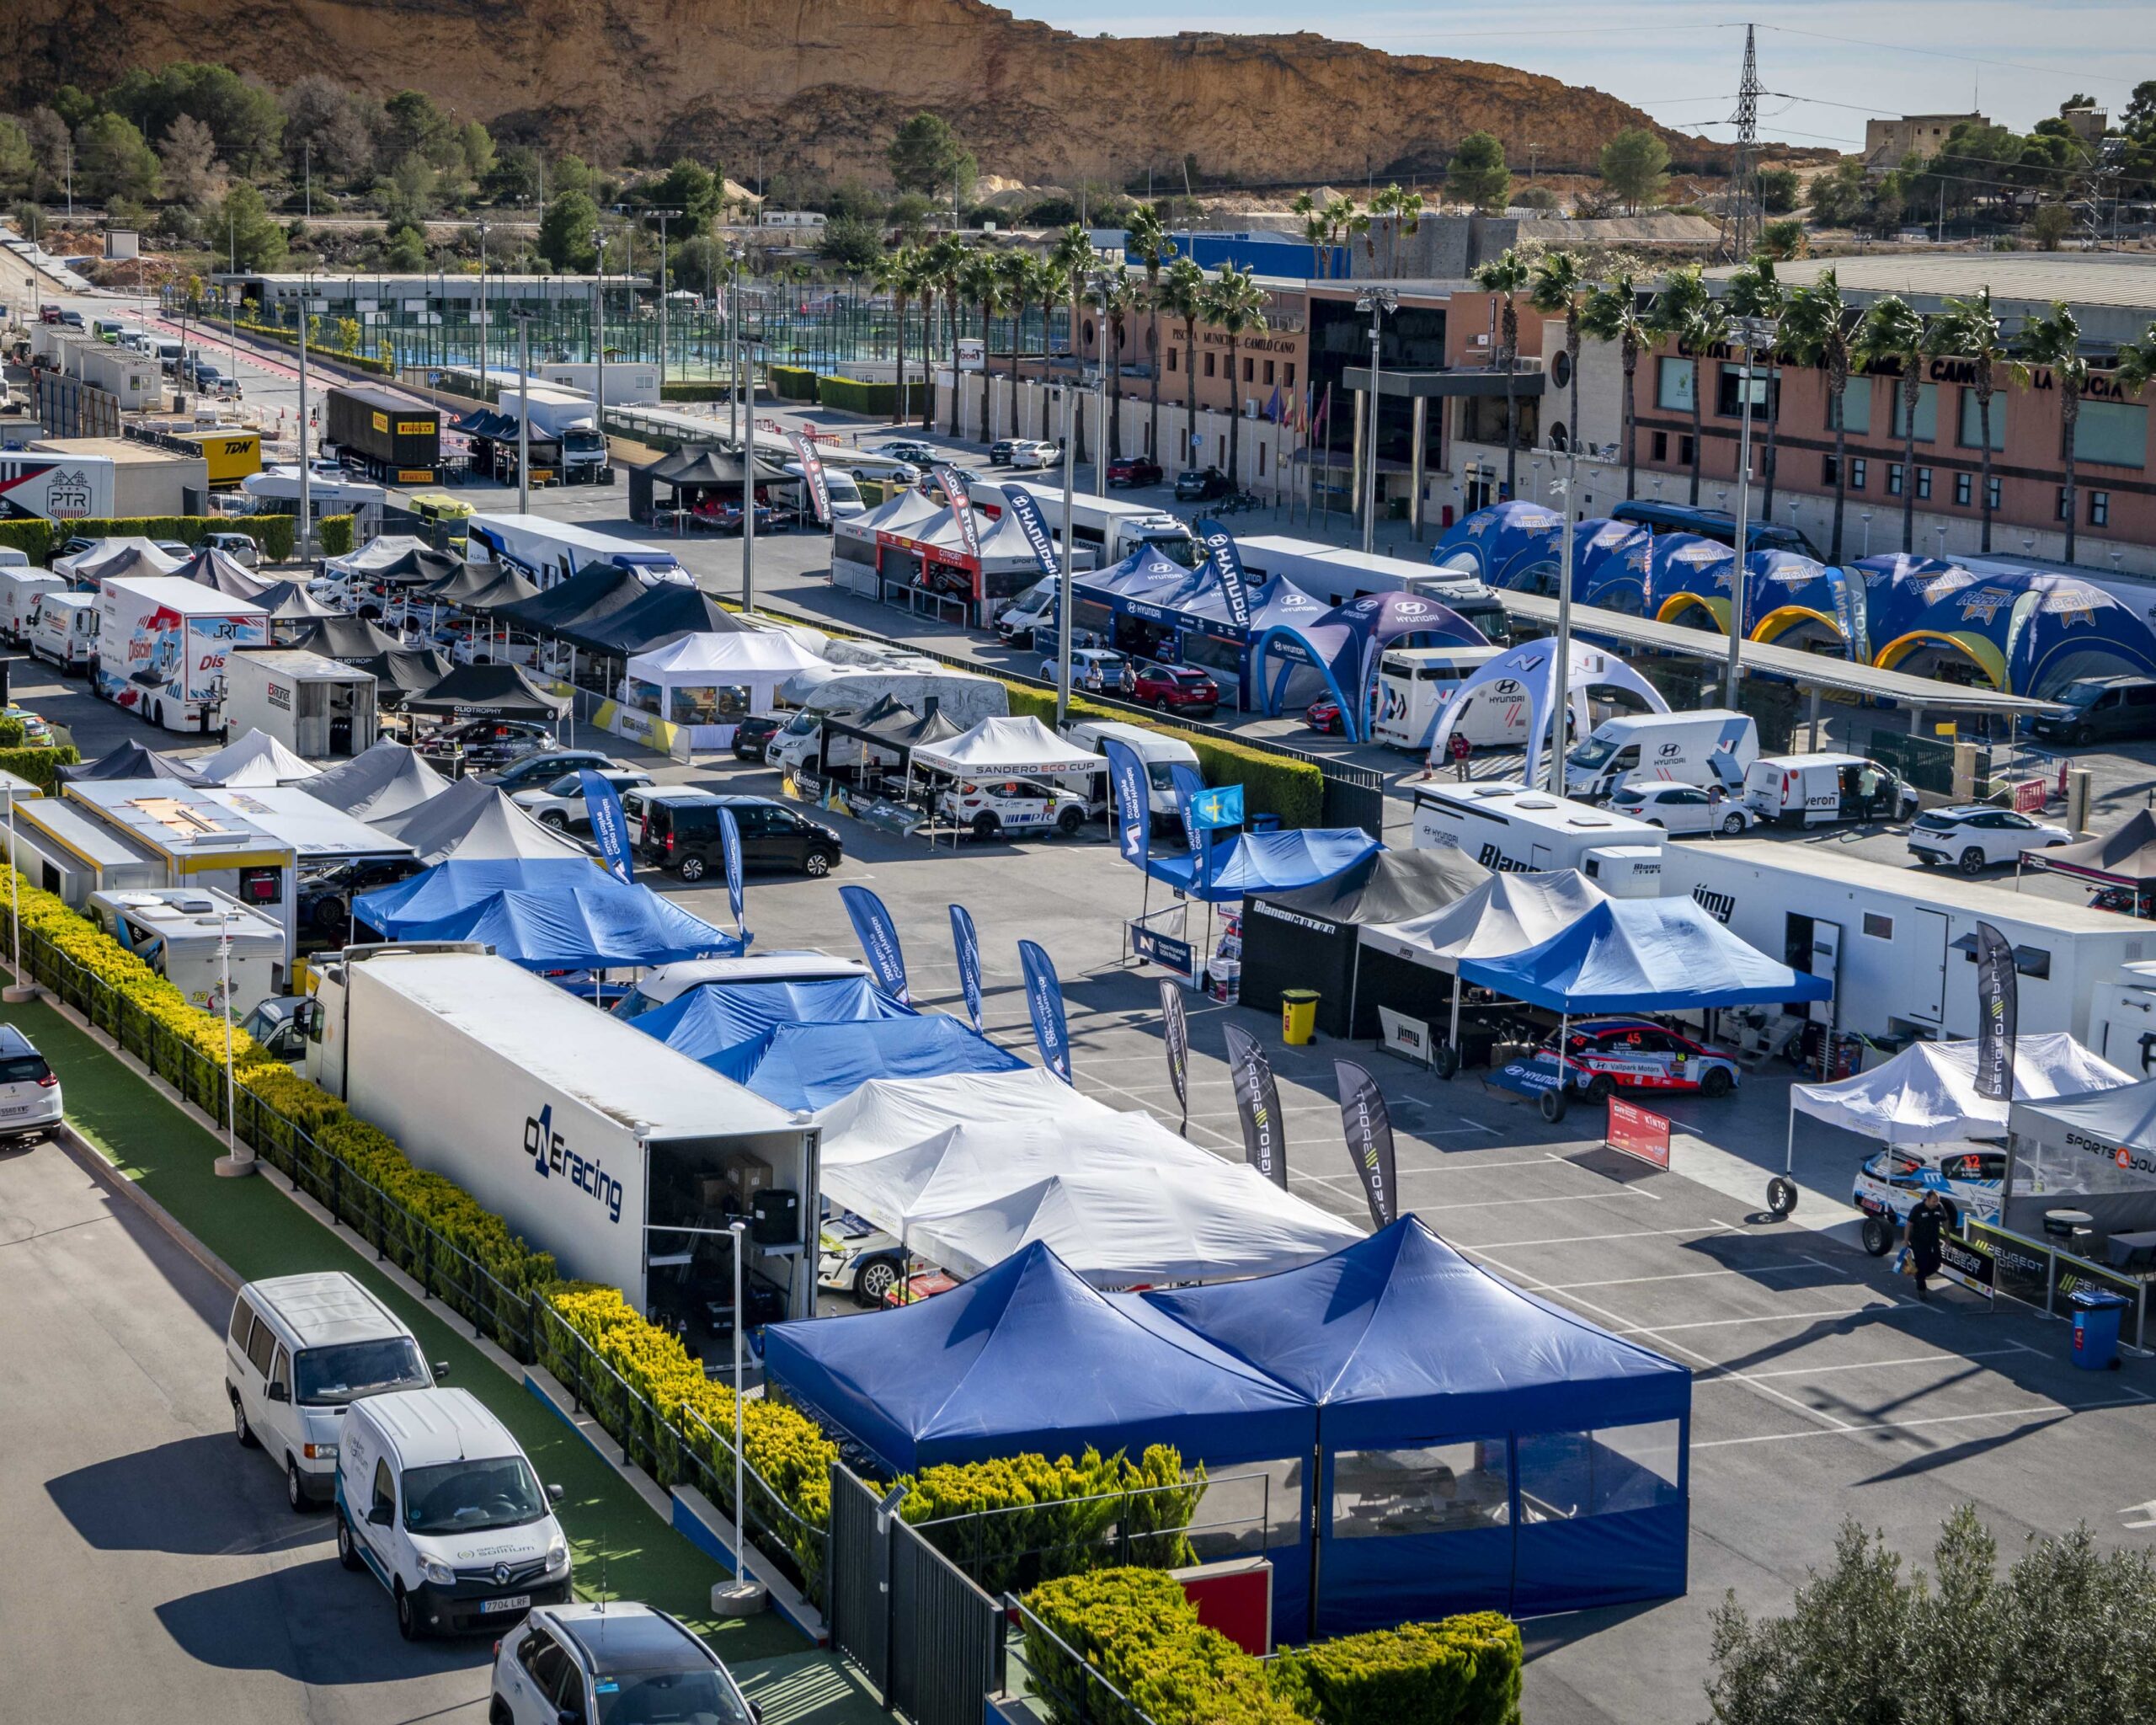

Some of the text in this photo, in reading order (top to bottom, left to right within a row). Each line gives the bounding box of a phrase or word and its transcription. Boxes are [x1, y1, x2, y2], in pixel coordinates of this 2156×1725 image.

[1245, 337, 1273, 352] CAMILO
[1273, 340, 1295, 354] CANO
[1929, 360, 1977, 384] CAN
[2034, 371, 2052, 390] LA
[225, 441, 253, 455] TDN
[51, 492, 87, 507] PTR
[1137, 606, 1161, 618] HYUNDAI
[1283, 644, 1306, 655] HYUNDAI
[1489, 696, 1525, 704] HYUNDAI
[454, 706, 502, 714] CLIOTROPHY
[913, 751, 937, 765] SANDERO
[937, 760, 947, 768] ECO
[1653, 757, 1686, 766] HYUNDAI
[976, 762, 1095, 774] SANDERO ECO CUP
[1432, 829, 1459, 843] HYUNDAI
[191, 991, 210, 1002] 13
[1397, 1024, 1420, 1047] jimy
[1627, 1033, 1642, 1044] 45
[1610, 1063, 1636, 1071] Vallpark
[1522, 1071, 1566, 1086] HYUNDAI
[1645, 1115, 1667, 1131] KINTO
[1940, 1249, 1980, 1275] EUGEOT
[1987, 1244, 2044, 1273] PEUGEOT
[487, 1595, 528, 1612] 7704 LRF
